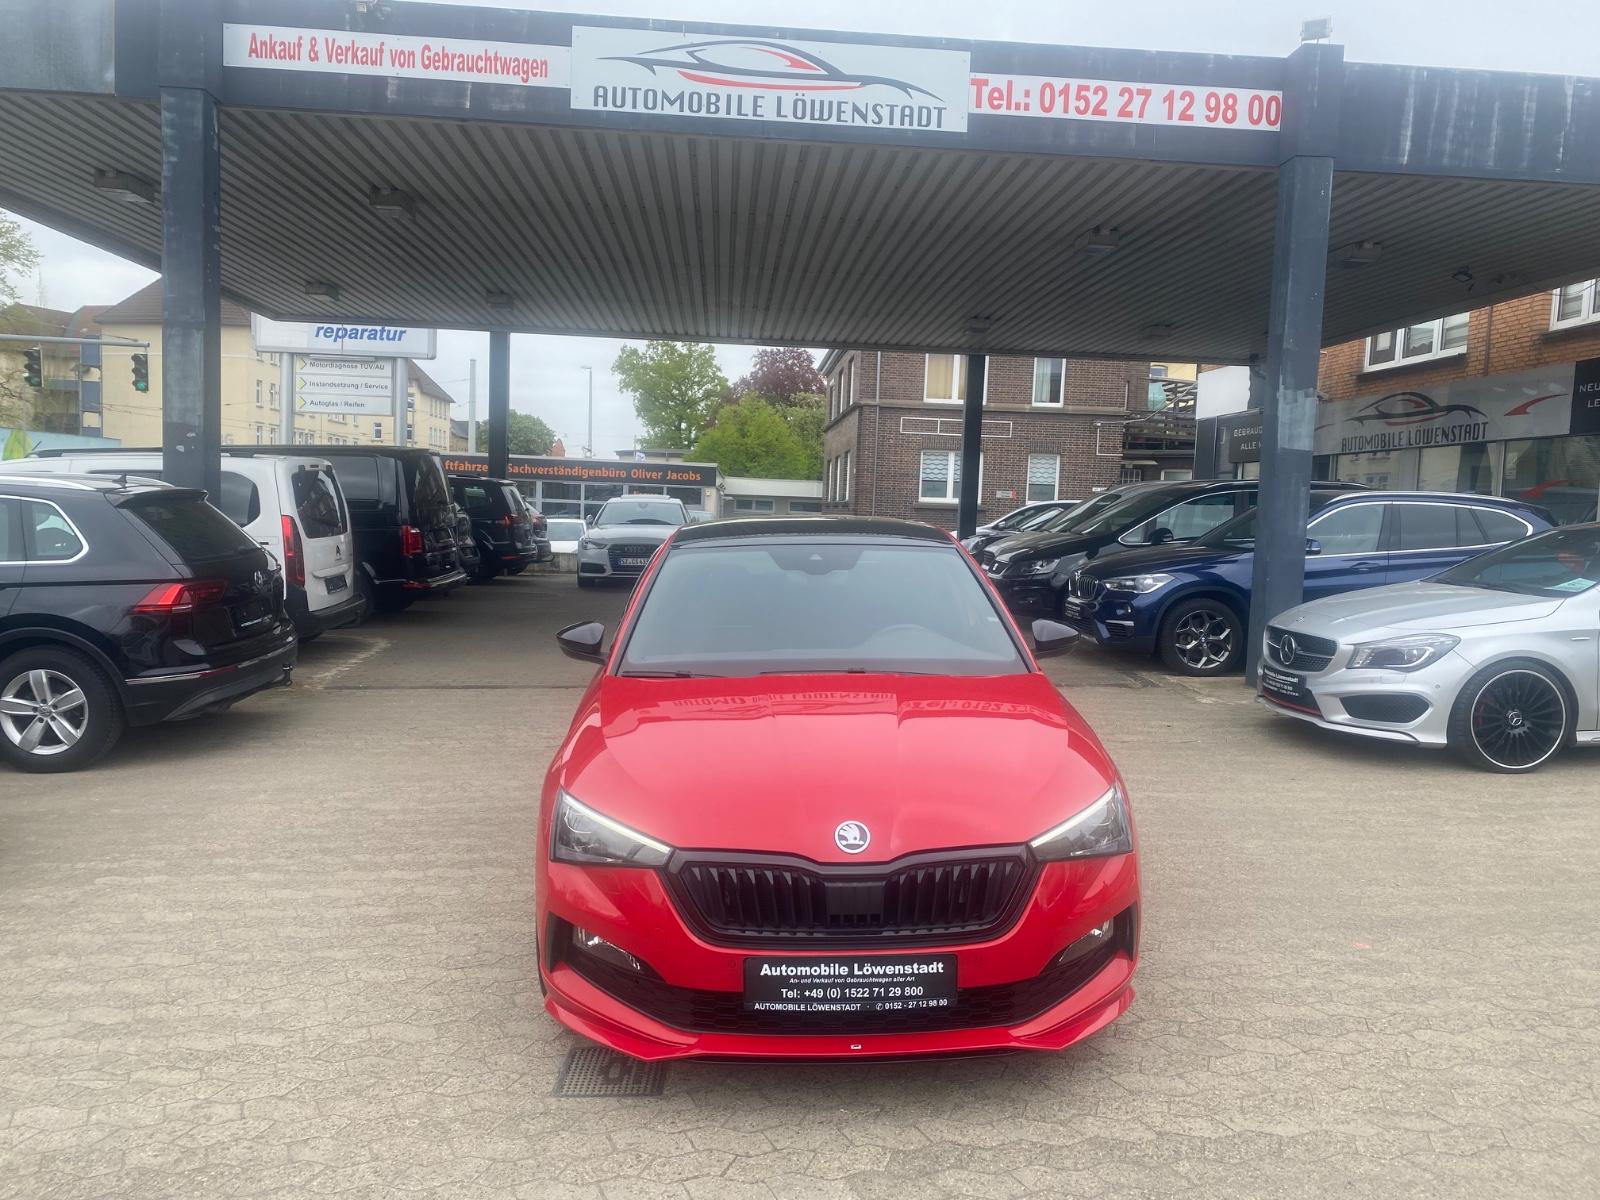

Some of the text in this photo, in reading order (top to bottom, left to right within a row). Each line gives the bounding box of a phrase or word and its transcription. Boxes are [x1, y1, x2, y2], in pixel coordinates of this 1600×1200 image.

[248, 32, 548, 83] Ankauf & Verkauf von Gebrauchtwagen
[593, 85, 947, 129] AUTOMOBILE LÖWENSTADT
[970, 78, 1281, 127] Tel.: 0152 27 12 98 00
[315, 325, 407, 342] reparatur
[309, 361, 358, 370] Motordiagnose
[309, 381, 359, 389] Instandsetzung
[364, 382, 388, 390] Service
[309, 400, 339, 408] Autoglas
[344, 400, 365, 408] Reifen
[1341, 421, 1488, 452] AUTOMOBILE LÖWENSTADT
[1240, 441, 1257, 450] ALLE
[508, 463, 626, 479] Sachverständigenbüro
[631, 468, 662, 479] Oliver
[666, 470, 701, 481] Jacobs
[760, 961, 944, 976] Automobile Löwenstadt
[846, 976, 892, 984] Gebrauchtwagen
[781, 986, 923, 1000] Tel: +49 (0) 1522 71 29 800
[754, 1003, 806, 1011] AUTOMOBILE
[807, 1002, 861, 1011] LÖWENSTADT
[885, 1002, 902, 1010] 0152
